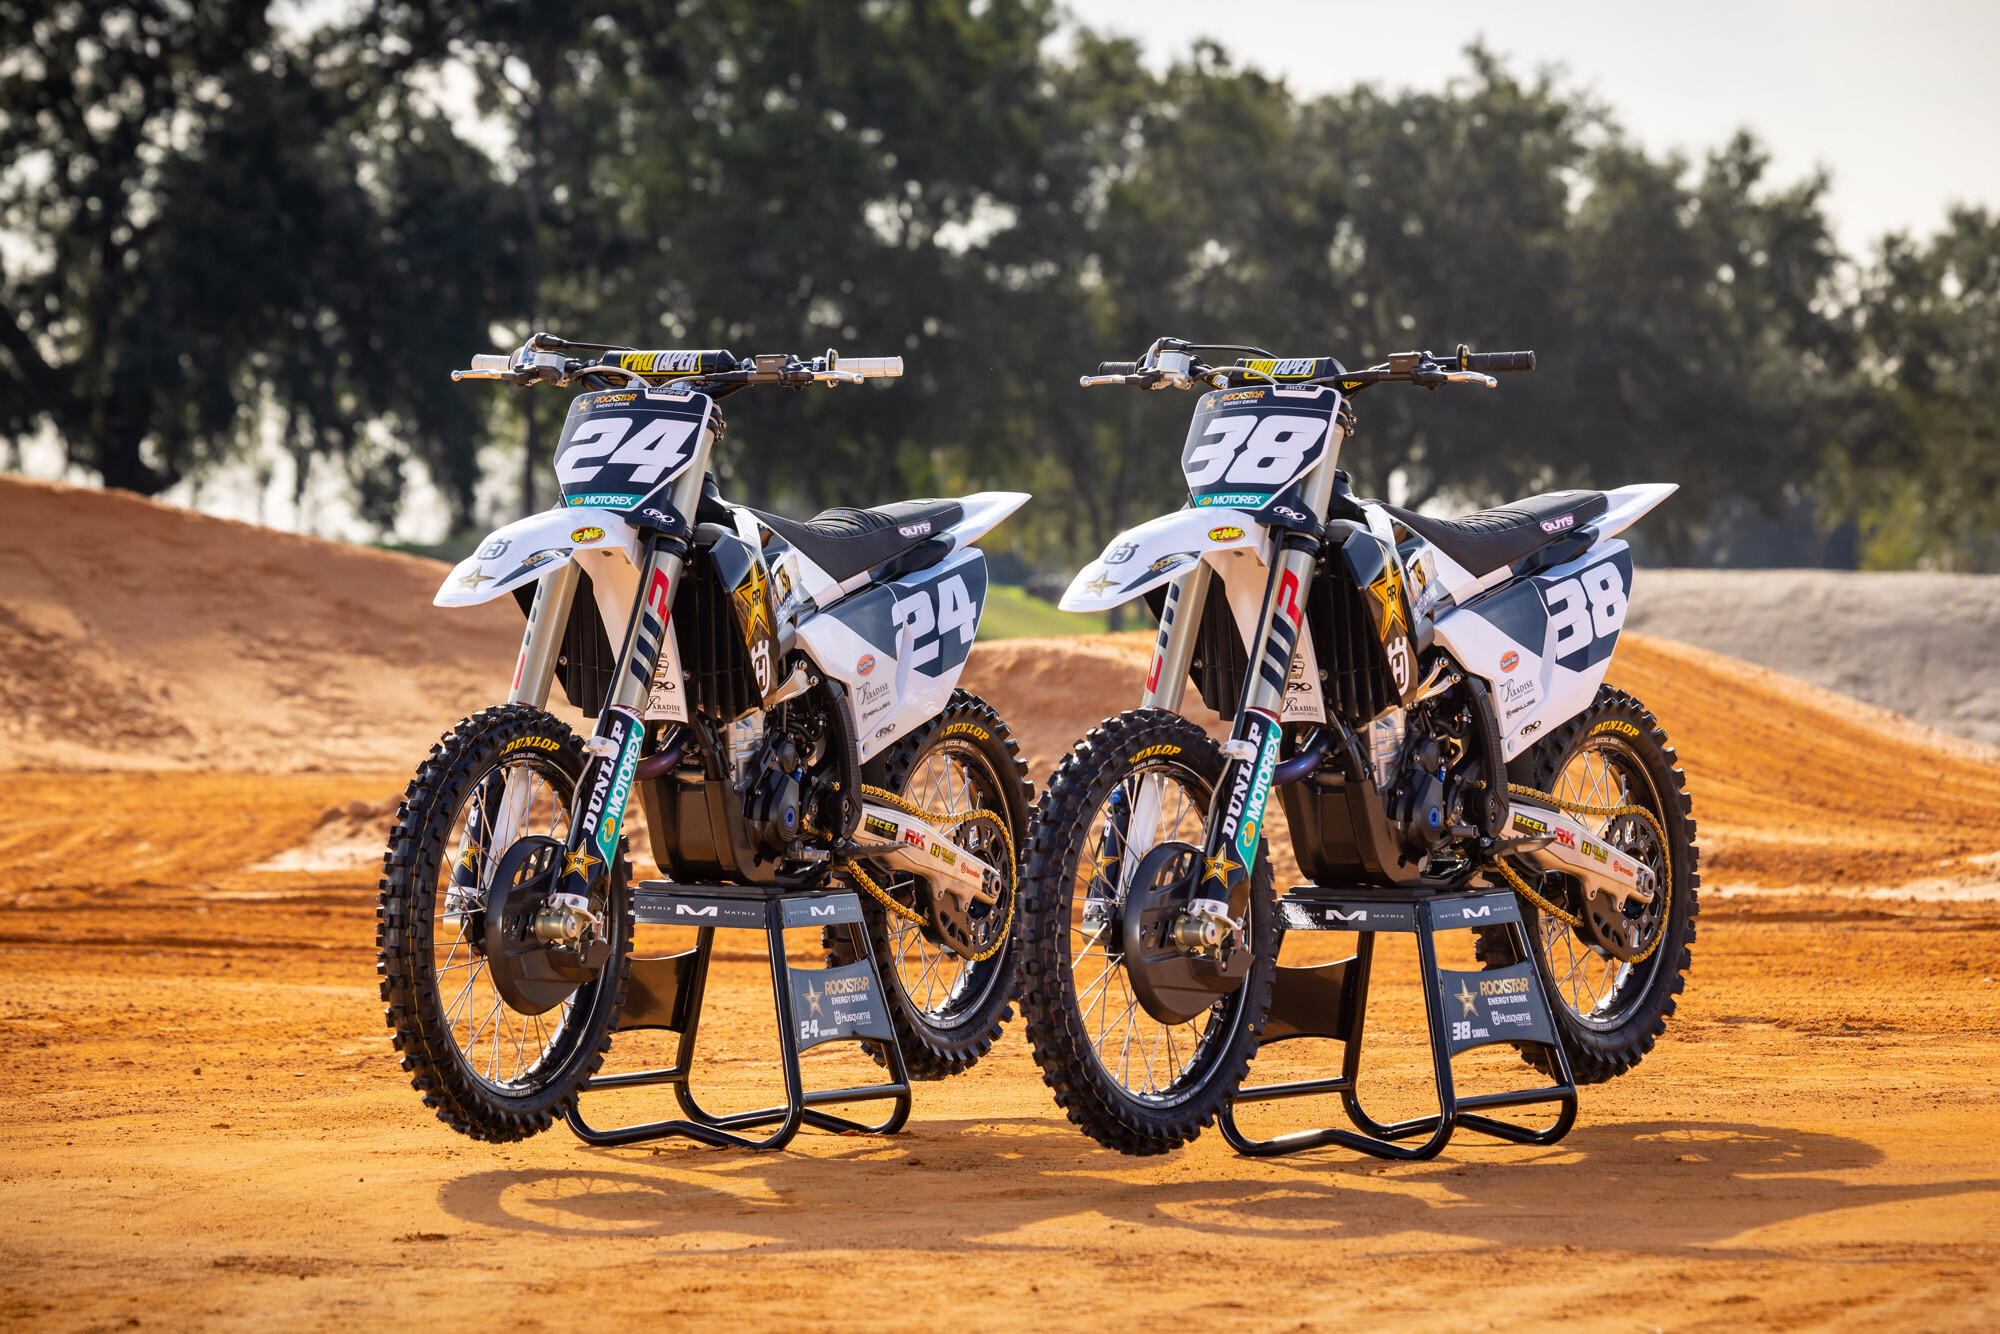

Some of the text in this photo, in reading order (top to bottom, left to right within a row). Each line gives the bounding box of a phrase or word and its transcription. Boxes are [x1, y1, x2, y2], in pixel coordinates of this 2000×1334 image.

[594, 393, 637, 404] ROCKSTAR
[1221, 391, 1265, 402] ROCKSTAR
[555, 417, 699, 484] 24
[1186, 415, 1328, 488] 38
[584, 496, 633, 505] MOTOREX
[1212, 495, 1262, 505] MOTOREX
[899, 522, 931, 537] GUTS
[1541, 515, 1574, 532] GUTS
[573, 528, 603, 542] FMF
[1210, 527, 1243, 541] FMF
[1545, 561, 1628, 660] 38
[891, 574, 977, 669] 24
[945, 723, 989, 740] DUNLOP
[1591, 720, 1640, 737] DUNLOP
[504, 736, 560, 754] DUNLOP
[582, 720, 625, 835] DUNLP
[607, 733, 643, 818] MOTOREX
[1222, 722, 1262, 840] DUNLP
[1247, 734, 1281, 822] MOTOREX
[867, 816, 897, 833] EXCEL
[1514, 814, 1546, 832] EXCEL
[904, 828, 926, 848] RK
[1555, 827, 1576, 847] RK
[966, 866, 980, 878] brembo
[1619, 865, 1634, 878] brembo
[824, 976, 870, 996] ROCKSTAR
[1479, 977, 1529, 996] ROCKSTAR
[831, 993, 868, 1005] ENERGY DRINK
[1487, 994, 1528, 1006] ENERGY DRINK
[841, 1011, 871, 1023] Husqvarna
[1500, 1012, 1531, 1023] Husqvarna
[801, 1019, 819, 1039] 24
[1452, 1021, 1490, 1040] 38 SWOLL
